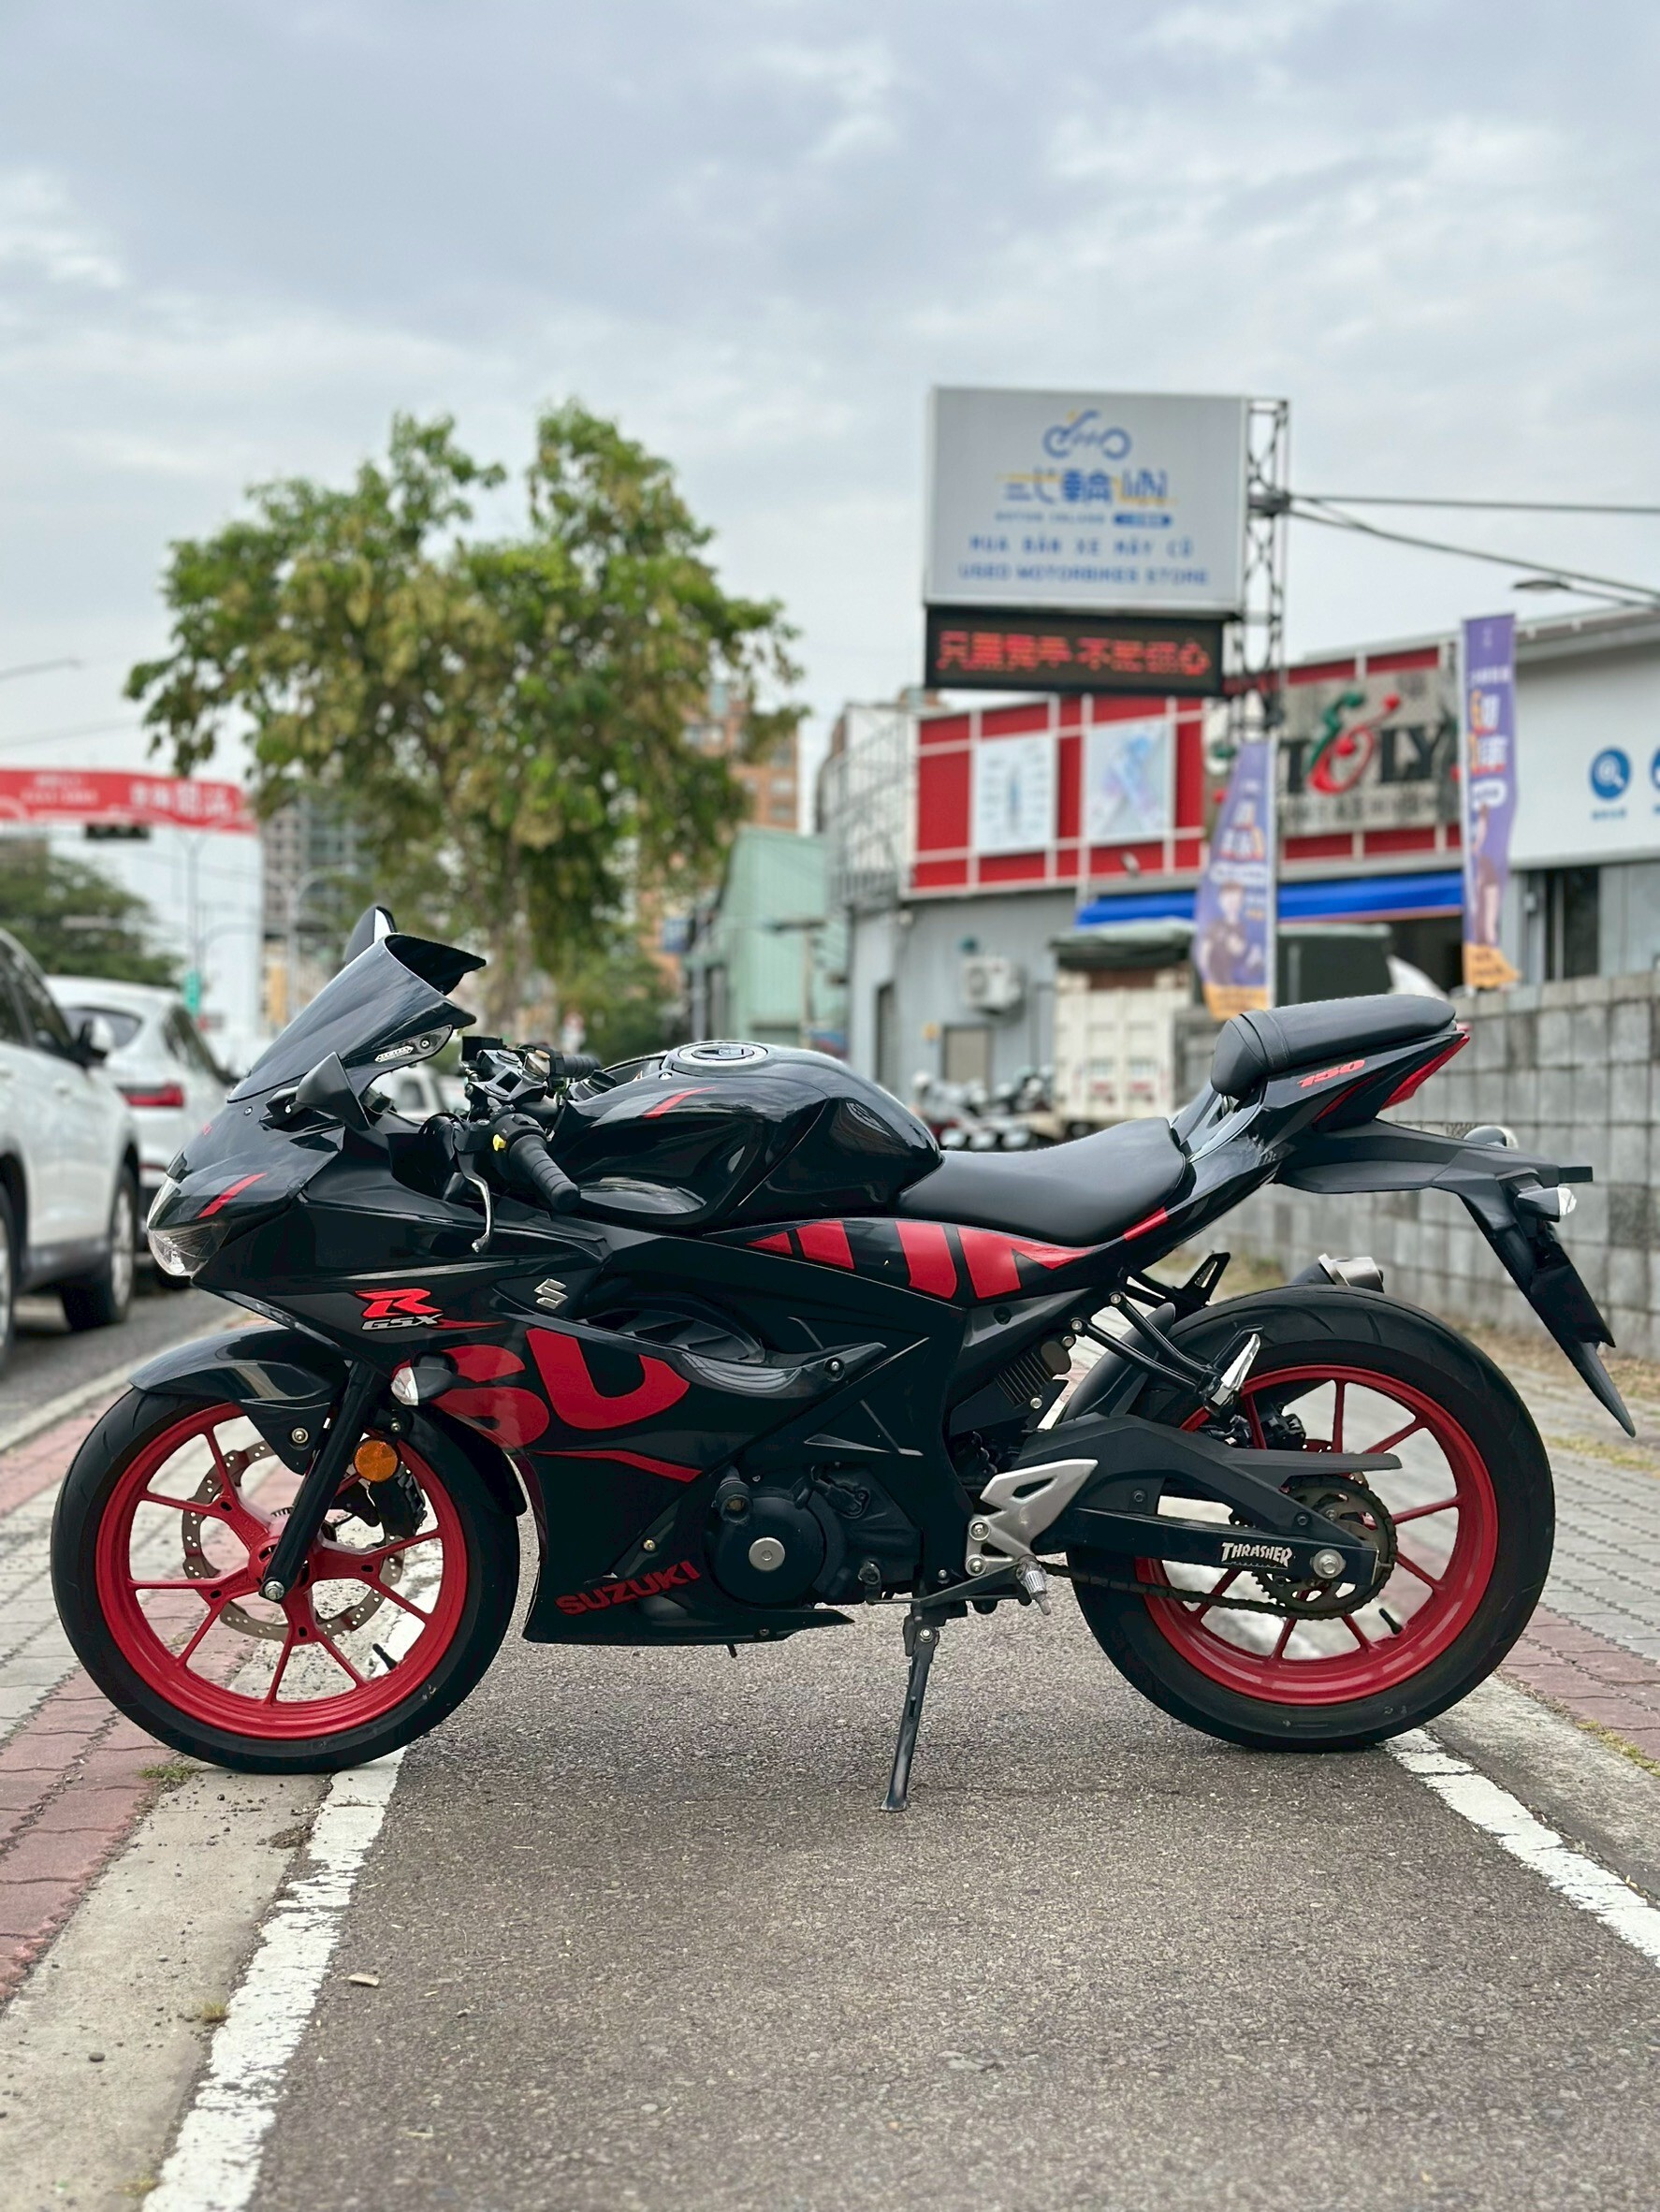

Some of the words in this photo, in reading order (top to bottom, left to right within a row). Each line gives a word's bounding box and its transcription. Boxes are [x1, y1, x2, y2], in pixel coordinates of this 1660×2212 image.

[356, 1288, 443, 1317] R
[361, 1314, 442, 1332] GSX
[1221, 1541, 1292, 1568] THRASHER
[555, 1560, 701, 1615] SUZUKI
